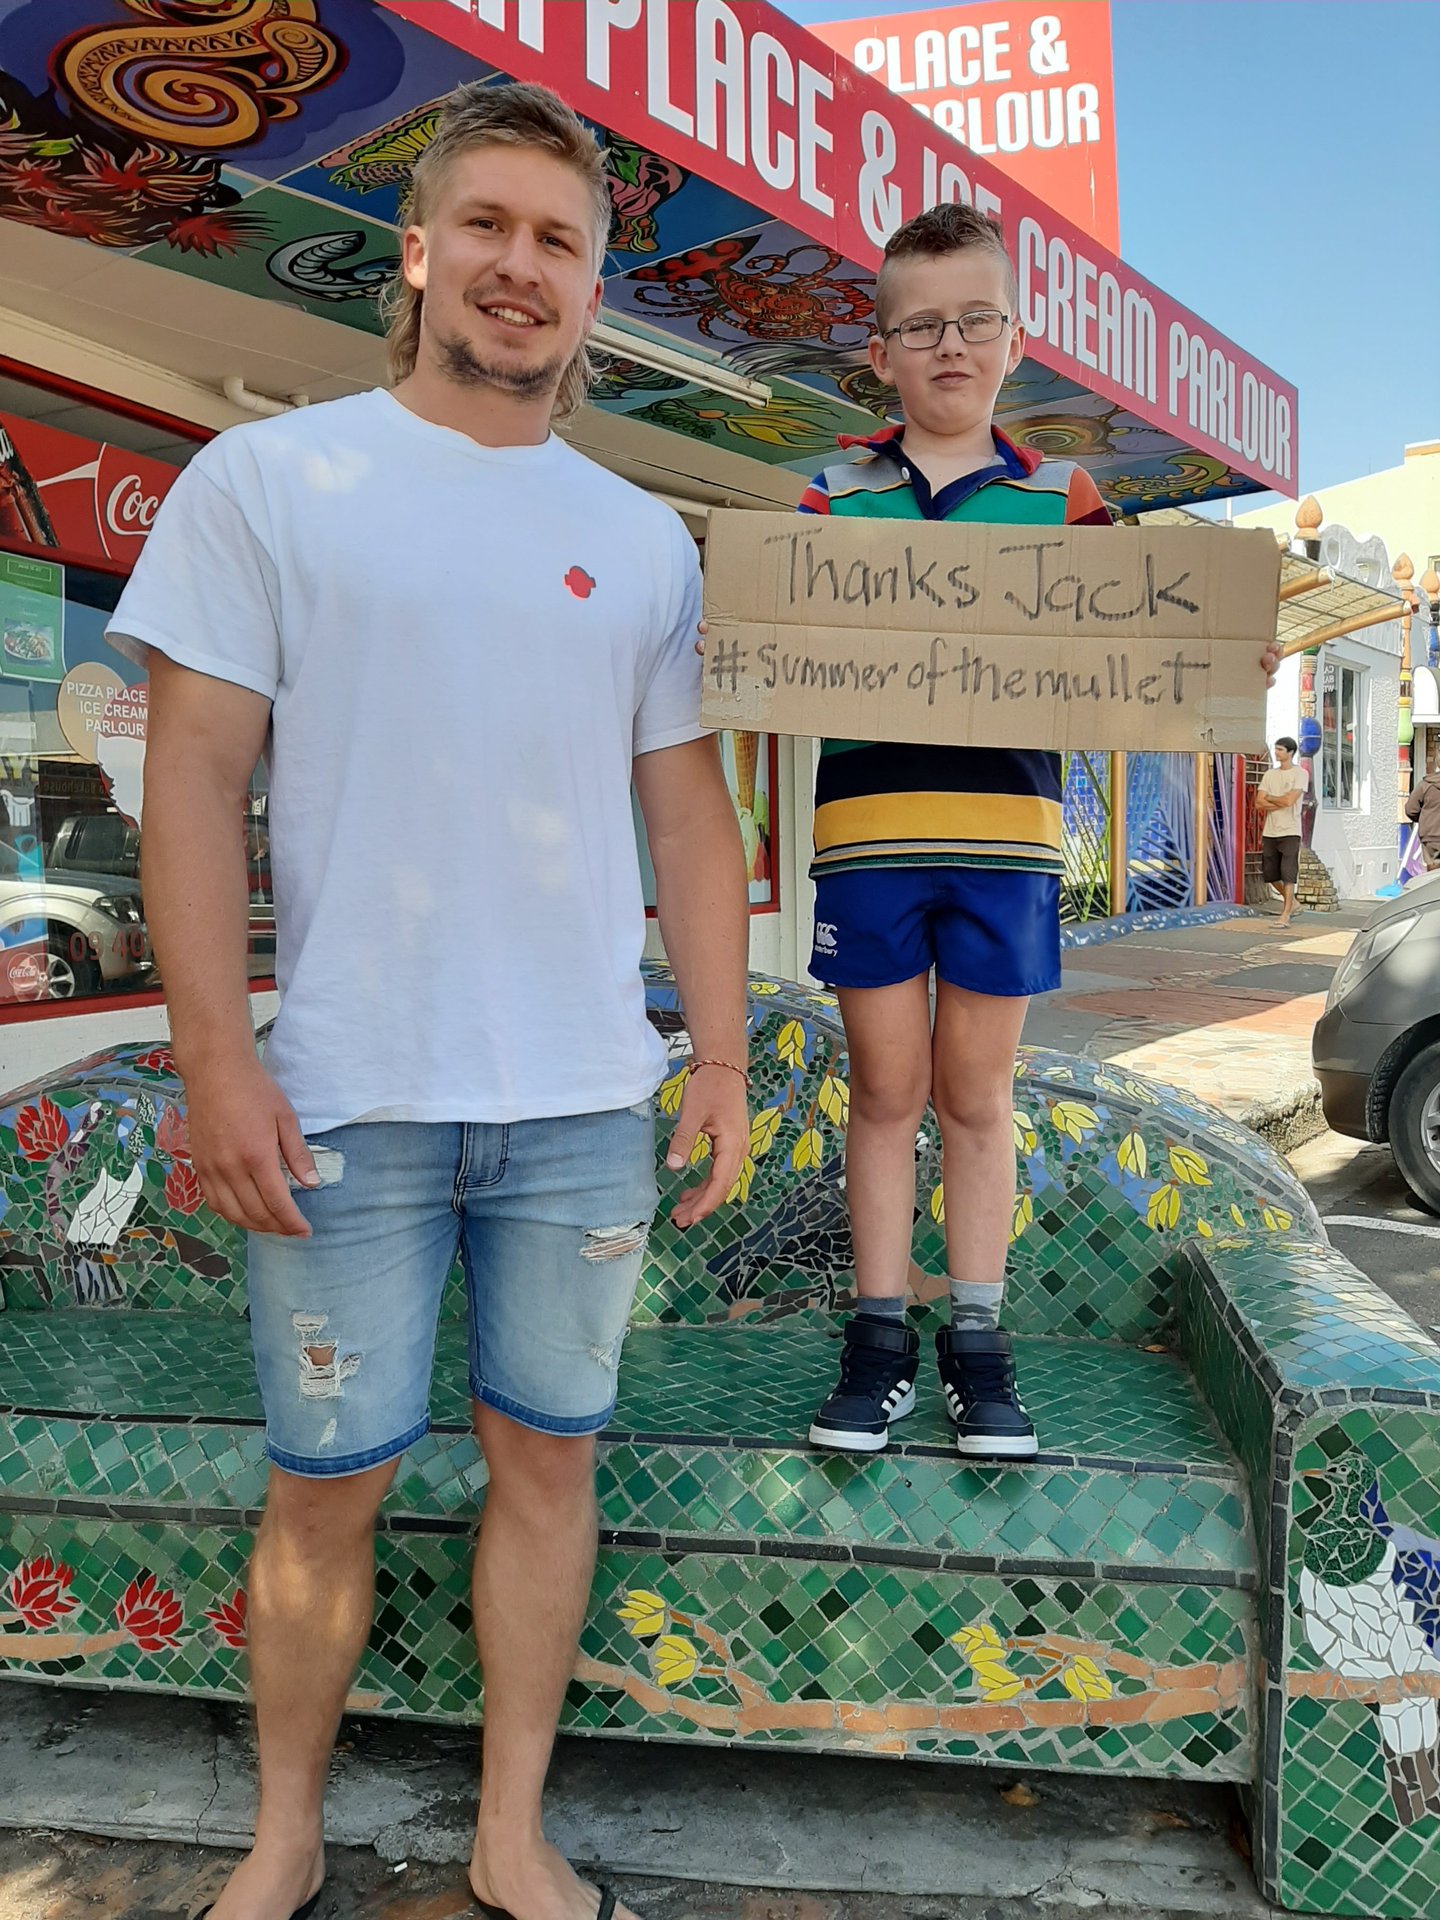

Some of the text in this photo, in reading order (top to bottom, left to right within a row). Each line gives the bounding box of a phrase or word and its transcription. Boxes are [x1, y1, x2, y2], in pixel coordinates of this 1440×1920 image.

[854, 15, 1070, 93] PLACE &
[911, 83, 1101, 155] RLOUR
[586, 0, 835, 218] PLACE
[859, 110, 903, 248] &
[1018, 216, 1158, 404] CREAM
[1168, 321, 1291, 481] PARLOUR
[764, 528, 1200, 622] Thanks Jack
[66, 681, 147, 704] PIZZA PLACE
[79, 700, 148, 721] ICE CREAM
[85, 719, 145, 737] PARLOUR
[69, 931, 104, 963] 09
